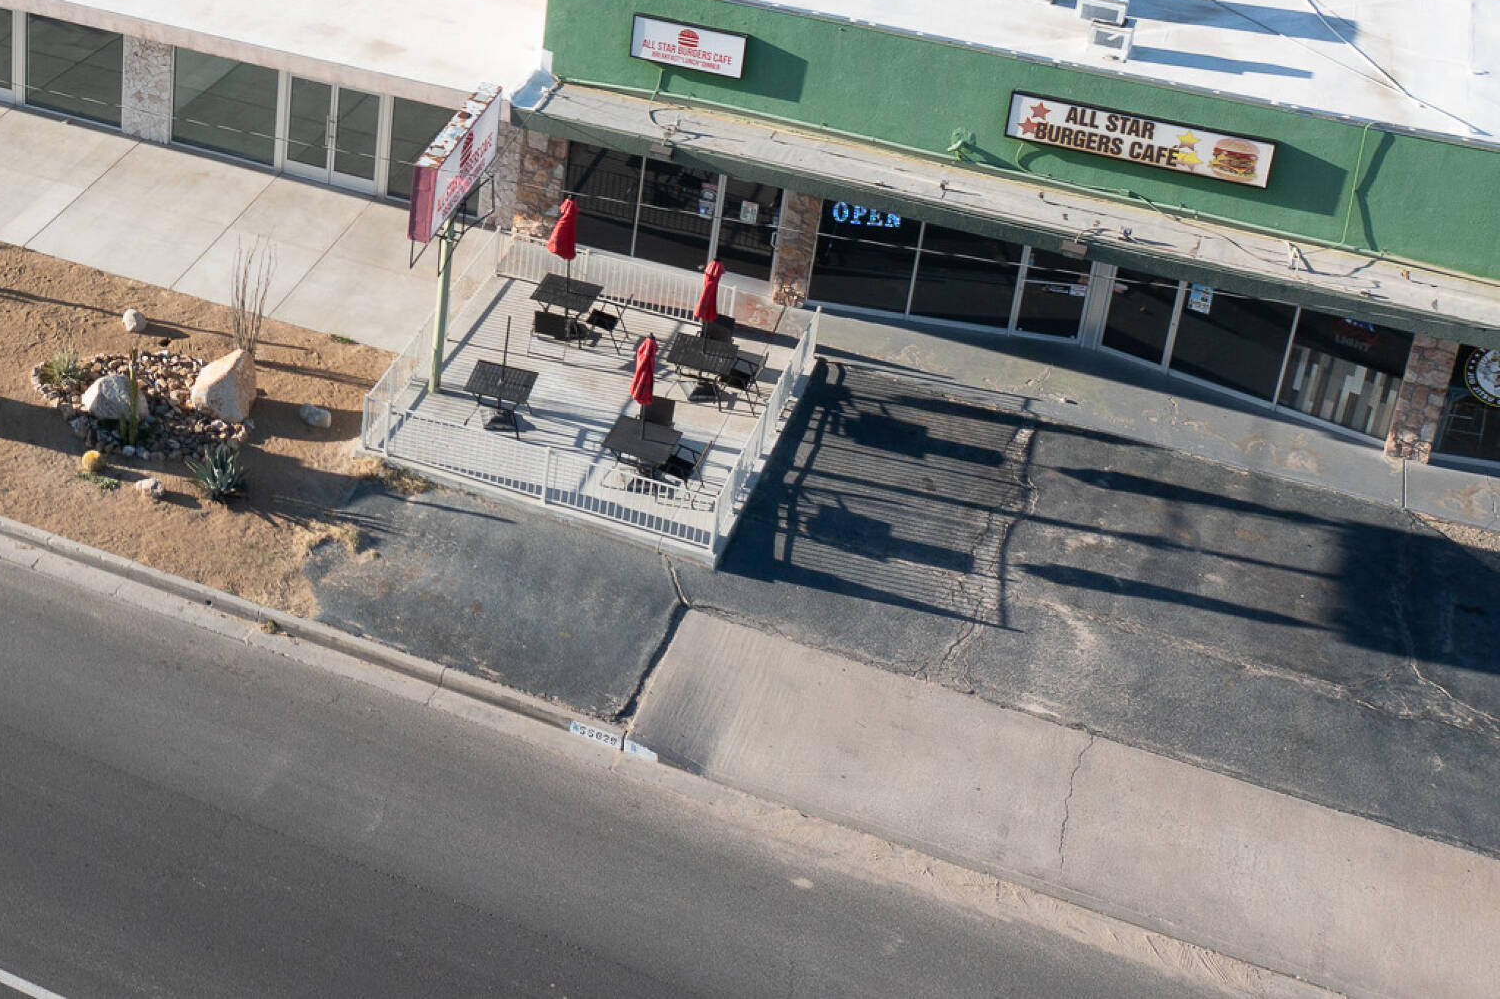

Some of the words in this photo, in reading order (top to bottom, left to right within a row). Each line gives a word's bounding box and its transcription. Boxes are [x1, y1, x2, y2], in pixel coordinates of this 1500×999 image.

[642, 38, 655, 51] ALL
[657, 41, 676, 54] STAR
[677, 46, 712, 61] BURGERS
[713, 53, 733, 65] CAFE
[1065, 106, 1099, 130] ALL
[1105, 114, 1155, 140] STAR
[1034, 122, 1124, 156] BURGERS
[1129, 140, 1180, 167] CAFÉ
[832, 201, 901, 228] OPEN
